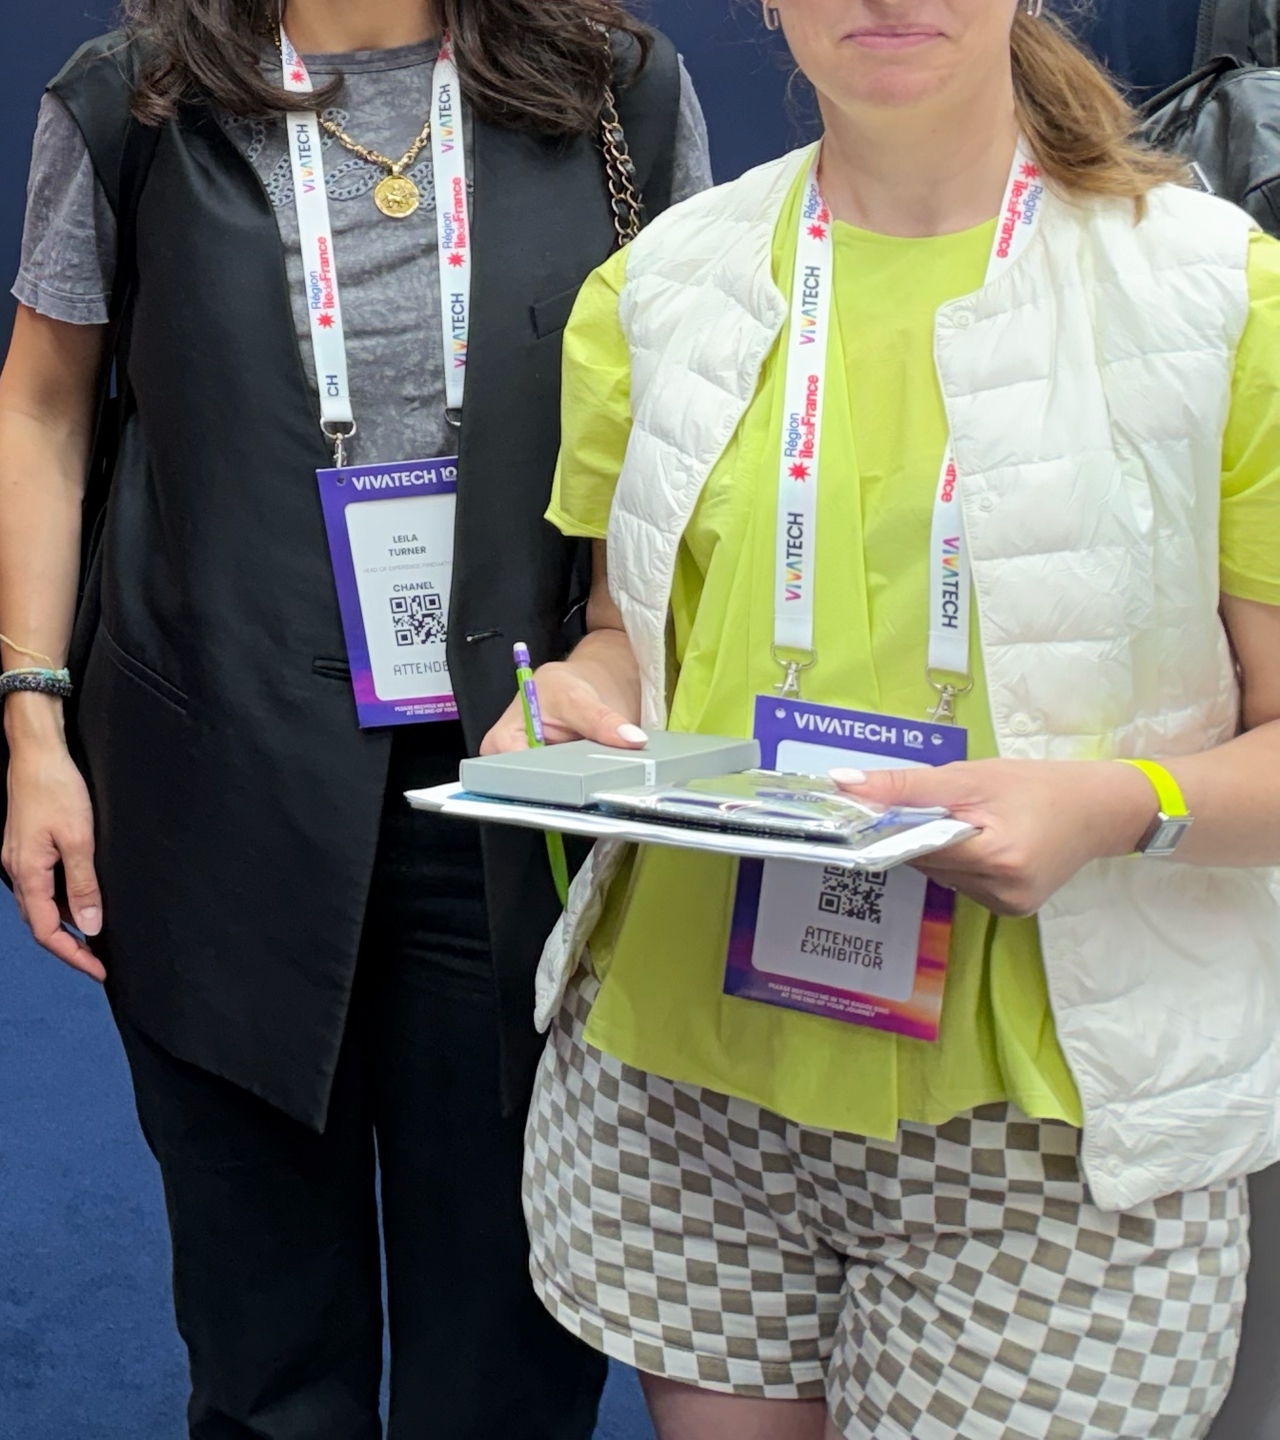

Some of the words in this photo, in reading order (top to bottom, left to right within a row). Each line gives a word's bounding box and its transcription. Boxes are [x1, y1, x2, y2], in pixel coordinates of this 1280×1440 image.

[439, 83, 454, 153] VIVATECH
[295, 123, 315, 193] VIVATECH
[1022, 185, 1043, 226] Région
[800, 265, 821, 345] VIVATECH
[451, 293, 467, 368] VIVATECH
[784, 412, 800, 457] Région
[352, 469, 436, 491] VIVATECH
[388, 546, 426, 557] TURNER
[393, 534, 418, 543] LEILA
[785, 512, 804, 602] VIVATECH
[393, 581, 435, 592] CHANEL
[942, 536, 960, 629] VIVATECH
[393, 660, 449, 676] ATTENDE
[794, 712, 897, 744] VIVATECH
[800, 940, 883, 971] EXHIBITOR
[804, 926, 883, 956] ATTENDEE
